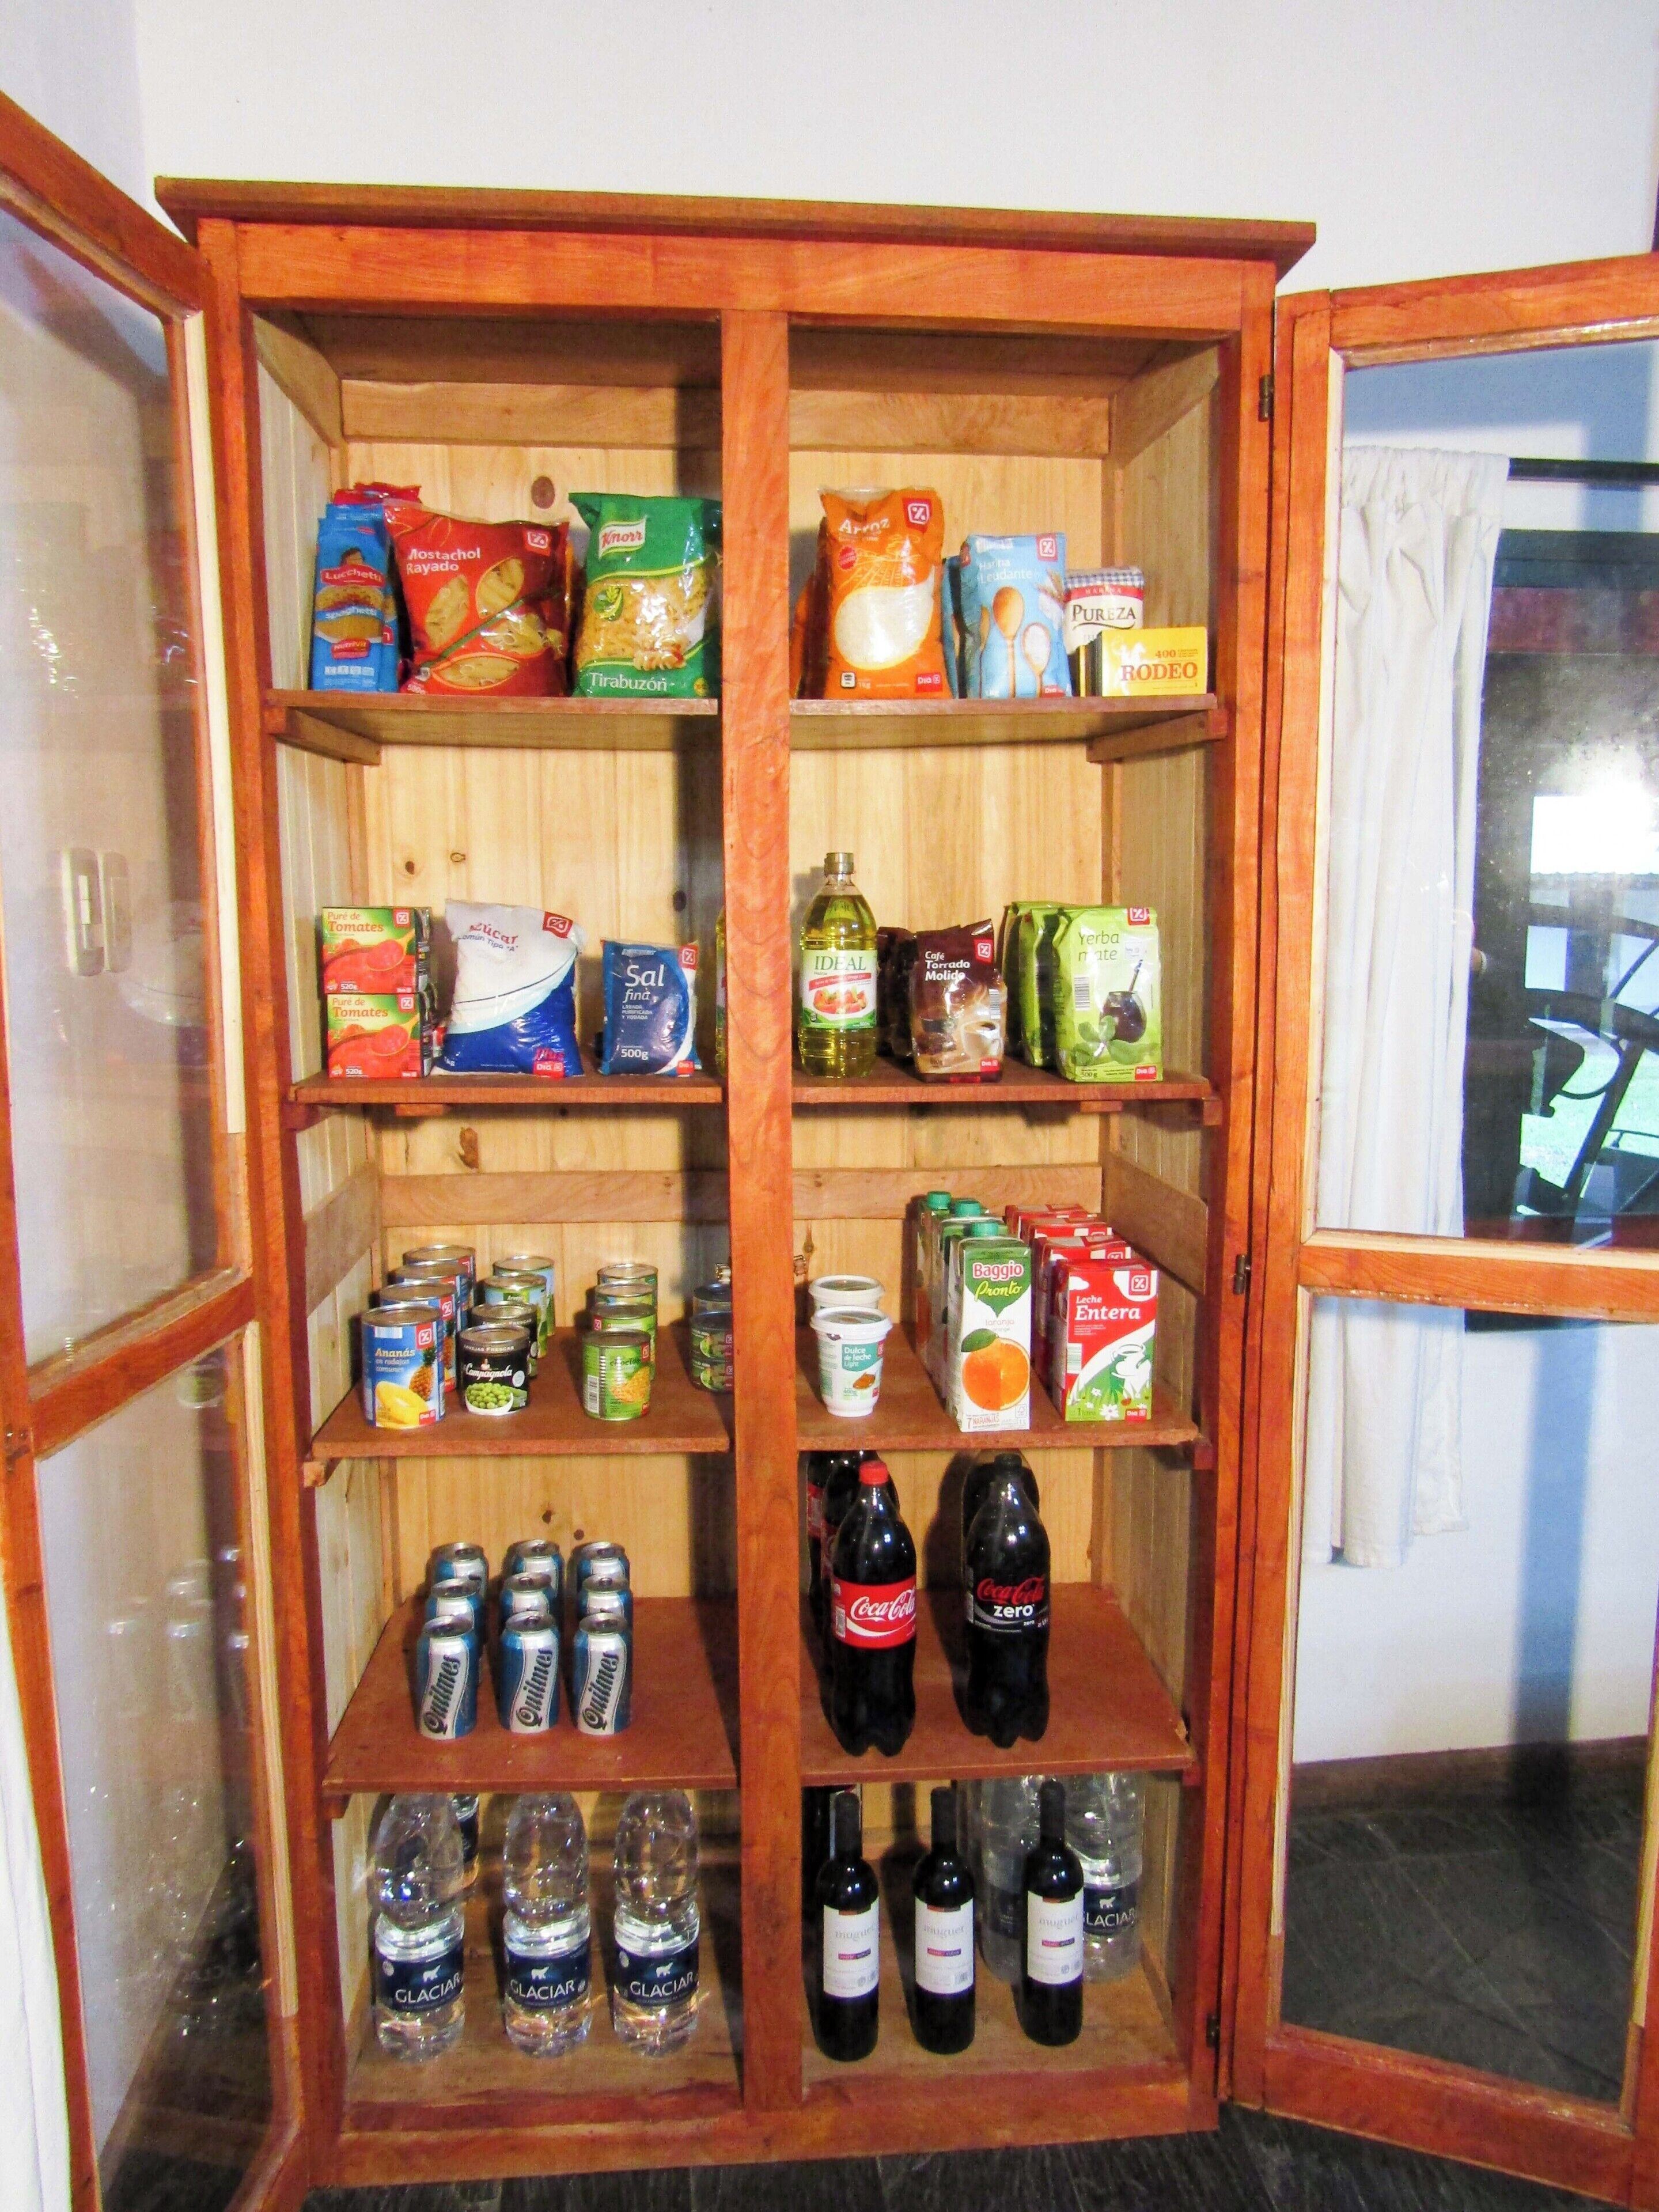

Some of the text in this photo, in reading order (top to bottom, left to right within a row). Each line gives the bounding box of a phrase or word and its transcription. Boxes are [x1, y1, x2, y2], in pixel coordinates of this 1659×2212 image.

[839, 518, 889, 535] Arroz
[601, 530, 642, 548] Knorr
[325, 568, 382, 583] Lucchetti
[406, 561, 459, 575] Rayado
[979, 569, 1033, 584] Leudante
[1071, 604, 1137, 622] PUREZA
[1155, 650, 1176, 658] 400
[1121, 662, 1198, 681] RODEO
[590, 672, 667, 692] Tirabuzón
[327, 912, 360, 921] Puré de
[328, 921, 384, 932] Tomates
[1078, 930, 1120, 945] Yerba
[815, 956, 866, 971] IDEAL
[925, 950, 945, 961] Café
[925, 960, 971, 969] Torrado
[625, 964, 665, 987] Sal
[925, 971, 965, 981] Molido
[332, 998, 351, 1006] Puré
[334, 1007, 388, 1017] Tomates
[620, 1049, 649, 1060] 500g
[973, 1260, 1024, 1281] Baggio
[974, 1281, 1022, 1302] Pronto
[1076, 1295, 1103, 1304] Leche
[1075, 1305, 1141, 1321] Entera
[376, 1347, 415, 1357] Ananás
[465, 1363, 513, 1381] Campagnola
[967, 1418, 972, 1429] 7
[972, 1415, 999, 1425] NARANJAS
[977, 1577, 1045, 1605] Coca-Cola
[850, 1588, 916, 1622] Coca-Cola
[994, 1604, 1033, 1618] zero
[423, 1654, 460, 1735] Quilmes
[516, 1648, 553, 1727] Quilmes
[582, 1650, 619, 1731] Quilmes
[1084, 1907, 1135, 1927] LACIAR
[395, 1972, 460, 2003] GLACIAR
[510, 1979, 575, 2000] GLACIAR
[630, 1971, 693, 1998] GLACIAR
